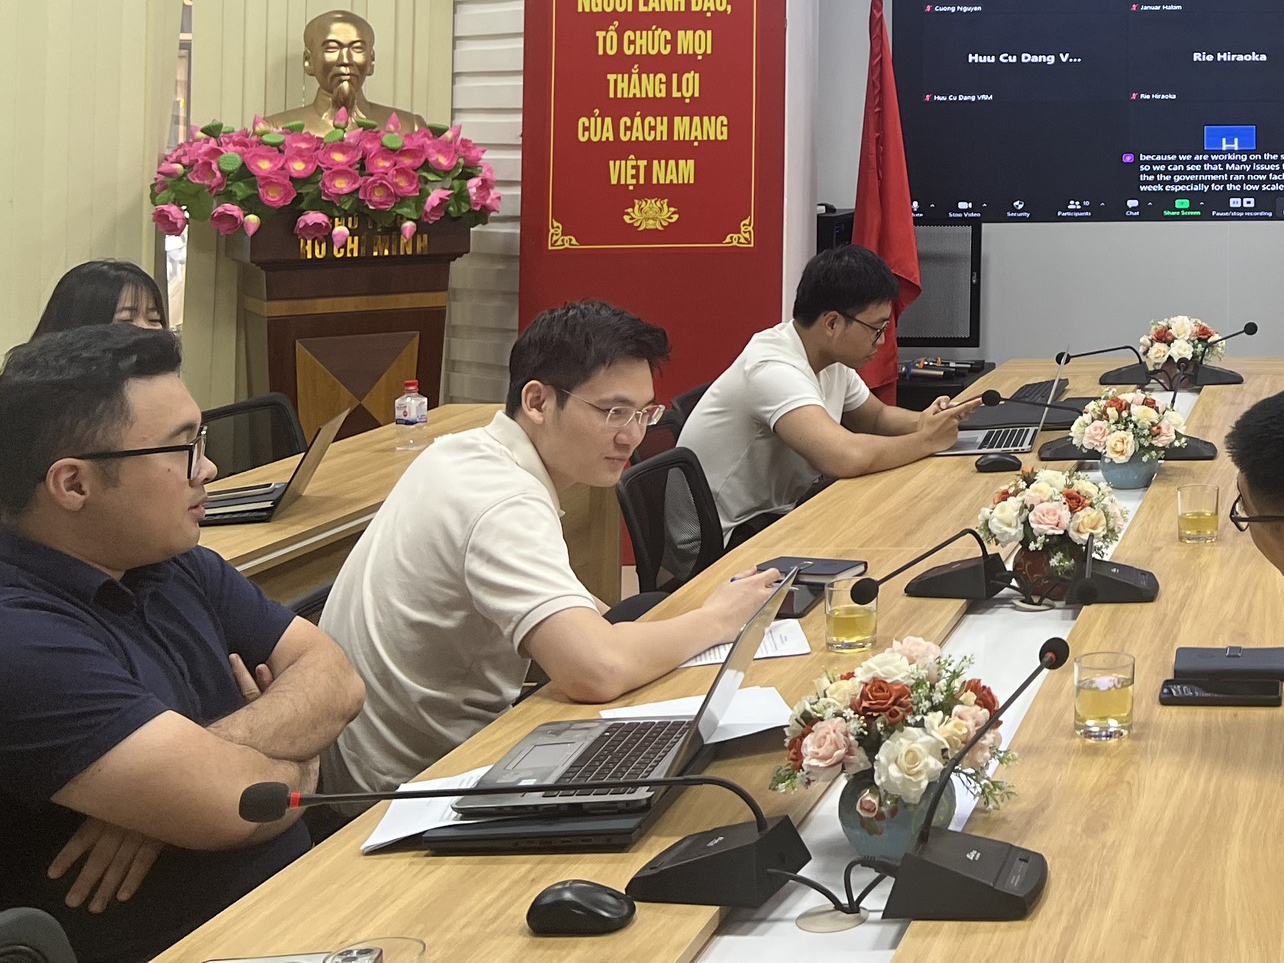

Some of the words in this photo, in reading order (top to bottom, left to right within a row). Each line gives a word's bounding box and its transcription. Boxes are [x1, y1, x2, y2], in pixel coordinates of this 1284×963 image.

[934, 5, 956, 13] Cuong
[956, 5, 982, 13] Nguyen
[595, 23, 619, 56] TỔ
[623, 25, 672, 56] CHỨC
[677, 30, 712, 60] MỌI
[968, 53, 996, 63] Huu
[998, 53, 1017, 63] Cu
[1021, 52, 1056, 65] Dang
[1059, 52, 1082, 63] V...
[1193, 51, 1215, 62] Rie
[1216, 51, 1267, 62] Hiraoka
[606, 65, 667, 99] THẮNG
[671, 71, 700, 103] LỢI
[577, 109, 614, 142] CỦA
[619, 112, 668, 142] CÁCH
[673, 116, 728, 147] MẠNG
[1139, 153, 1177, 161] because
[1210, 152, 1248, 162] working
[1263, 152, 1279, 160] the
[608, 155, 648, 190] VIỆT
[652, 160, 695, 185] NAM
[1139, 164, 1151, 172] so
[1225, 163, 1252, 172] Many
[1139, 173, 1155, 181] the
[1156, 173, 1172, 181] the
[1173, 173, 1228, 183] government
[1139, 183, 1164, 192] week
[1164, 183, 1210, 193] especially
[1210, 182, 1225, 191] for
[1226, 182, 1242, 191] the
[1242, 182, 1260, 191] low
[1261, 182, 1284, 191] scale
[372, 233, 429, 257] MINH
